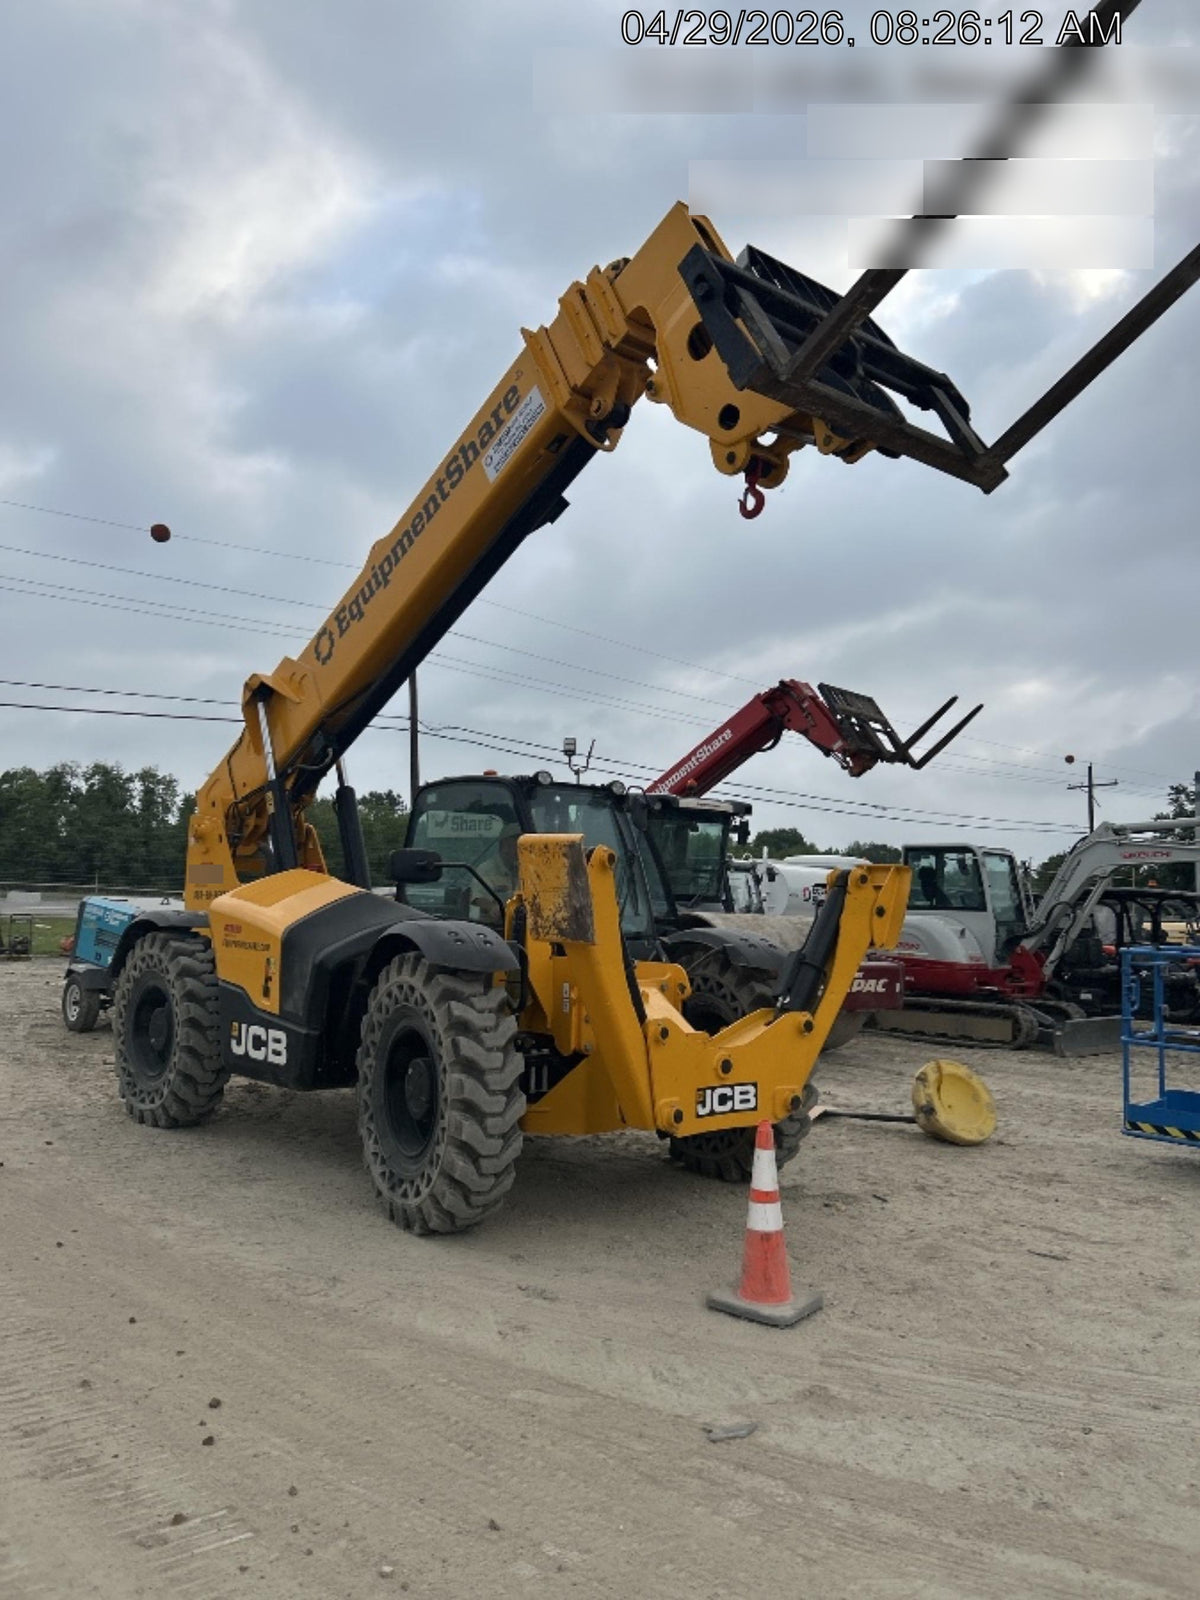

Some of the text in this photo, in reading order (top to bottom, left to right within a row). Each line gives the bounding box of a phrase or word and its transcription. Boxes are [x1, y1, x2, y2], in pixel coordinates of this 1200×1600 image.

[333, 384, 521, 639] EquipmentShare
[847, 979, 888, 992] PAC
[231, 1022, 287, 1066] JCB
[696, 1084, 757, 1116] JCB
